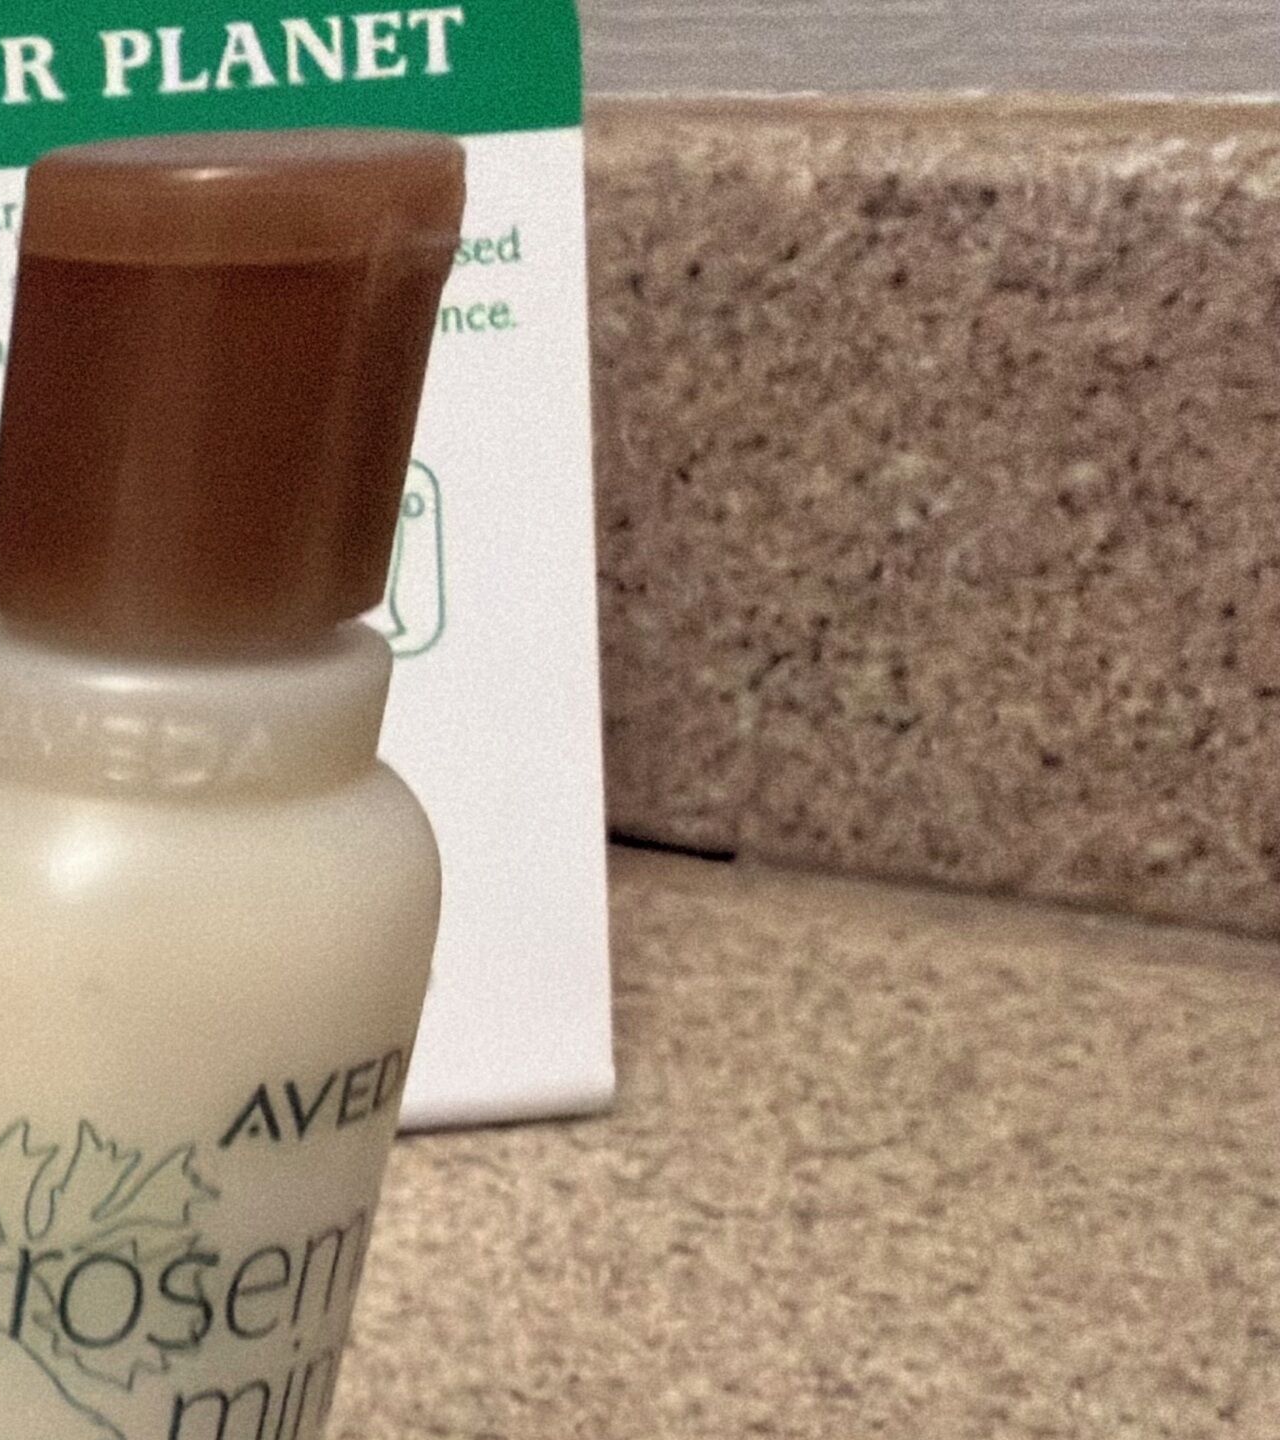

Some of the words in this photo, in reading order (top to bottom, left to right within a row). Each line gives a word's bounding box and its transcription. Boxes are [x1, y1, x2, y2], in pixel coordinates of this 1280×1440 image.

[102, 7, 467, 98] PLANET
[453, 225, 522, 266] sed
[441, 301, 517, 334] nce.
[218, 1048, 403, 1149] AVED
[11, 1207, 367, 1350] rosem
